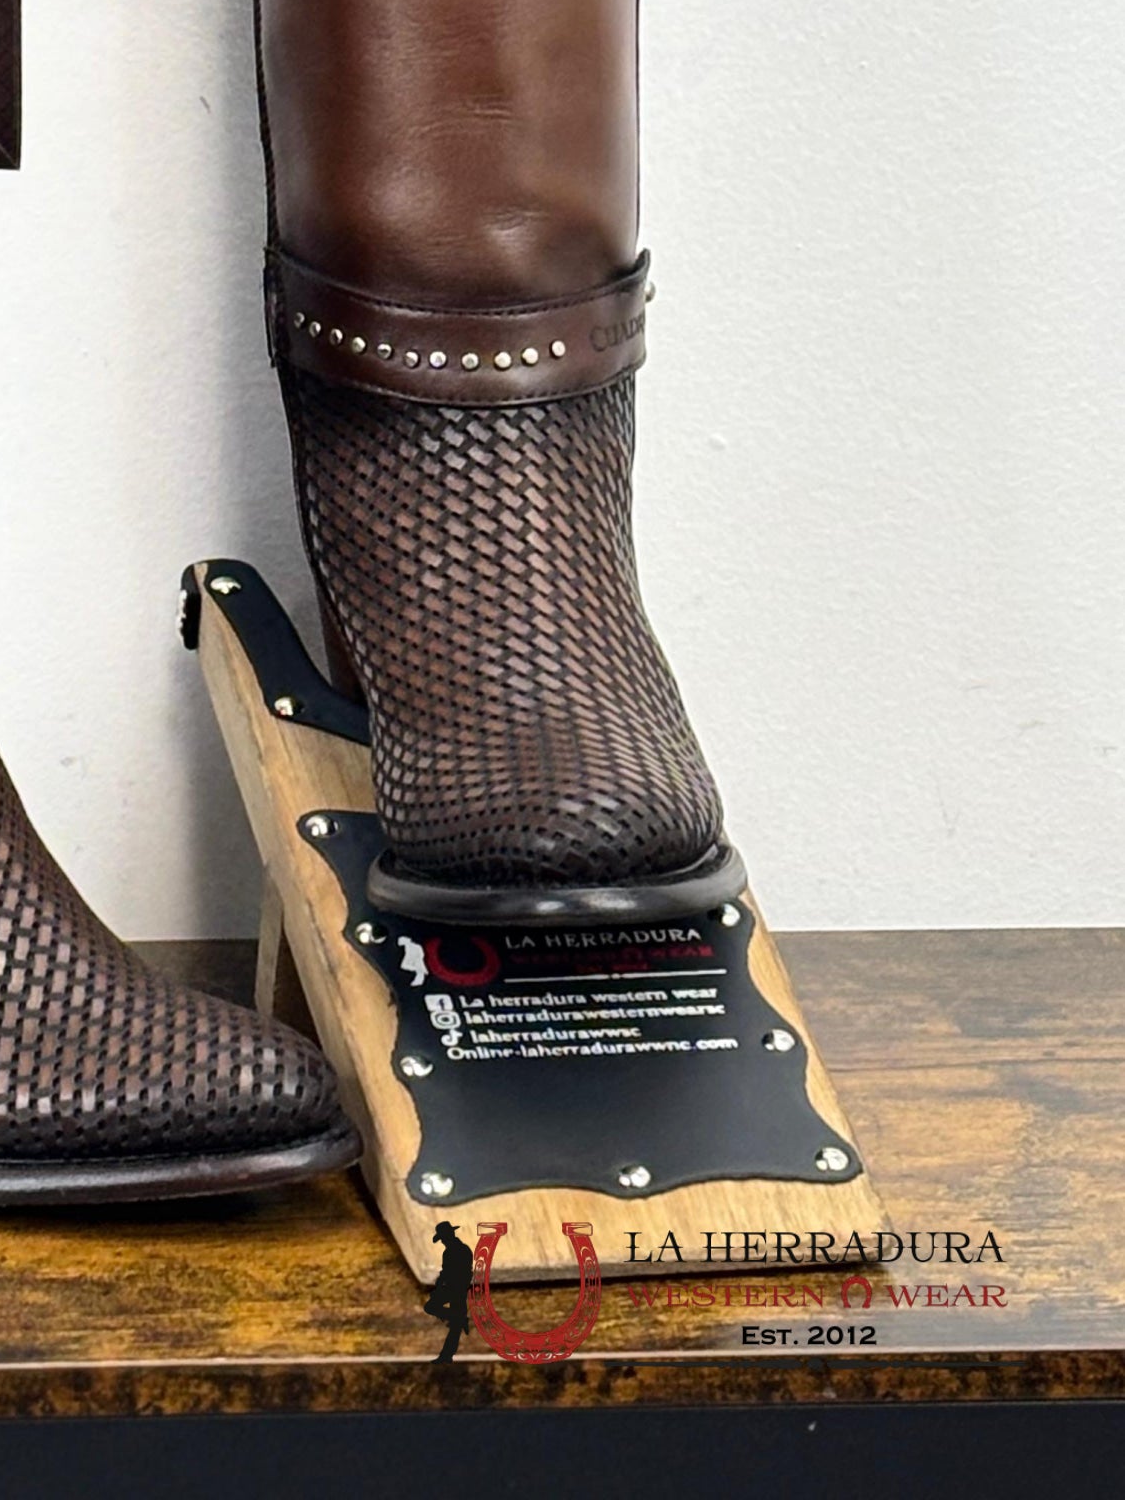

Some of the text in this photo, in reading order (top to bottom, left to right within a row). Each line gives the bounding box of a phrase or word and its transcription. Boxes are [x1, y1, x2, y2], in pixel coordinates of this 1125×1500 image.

[506, 928, 701, 950] LA HERRADURA
[460, 987, 718, 1009] La herradura western wear
